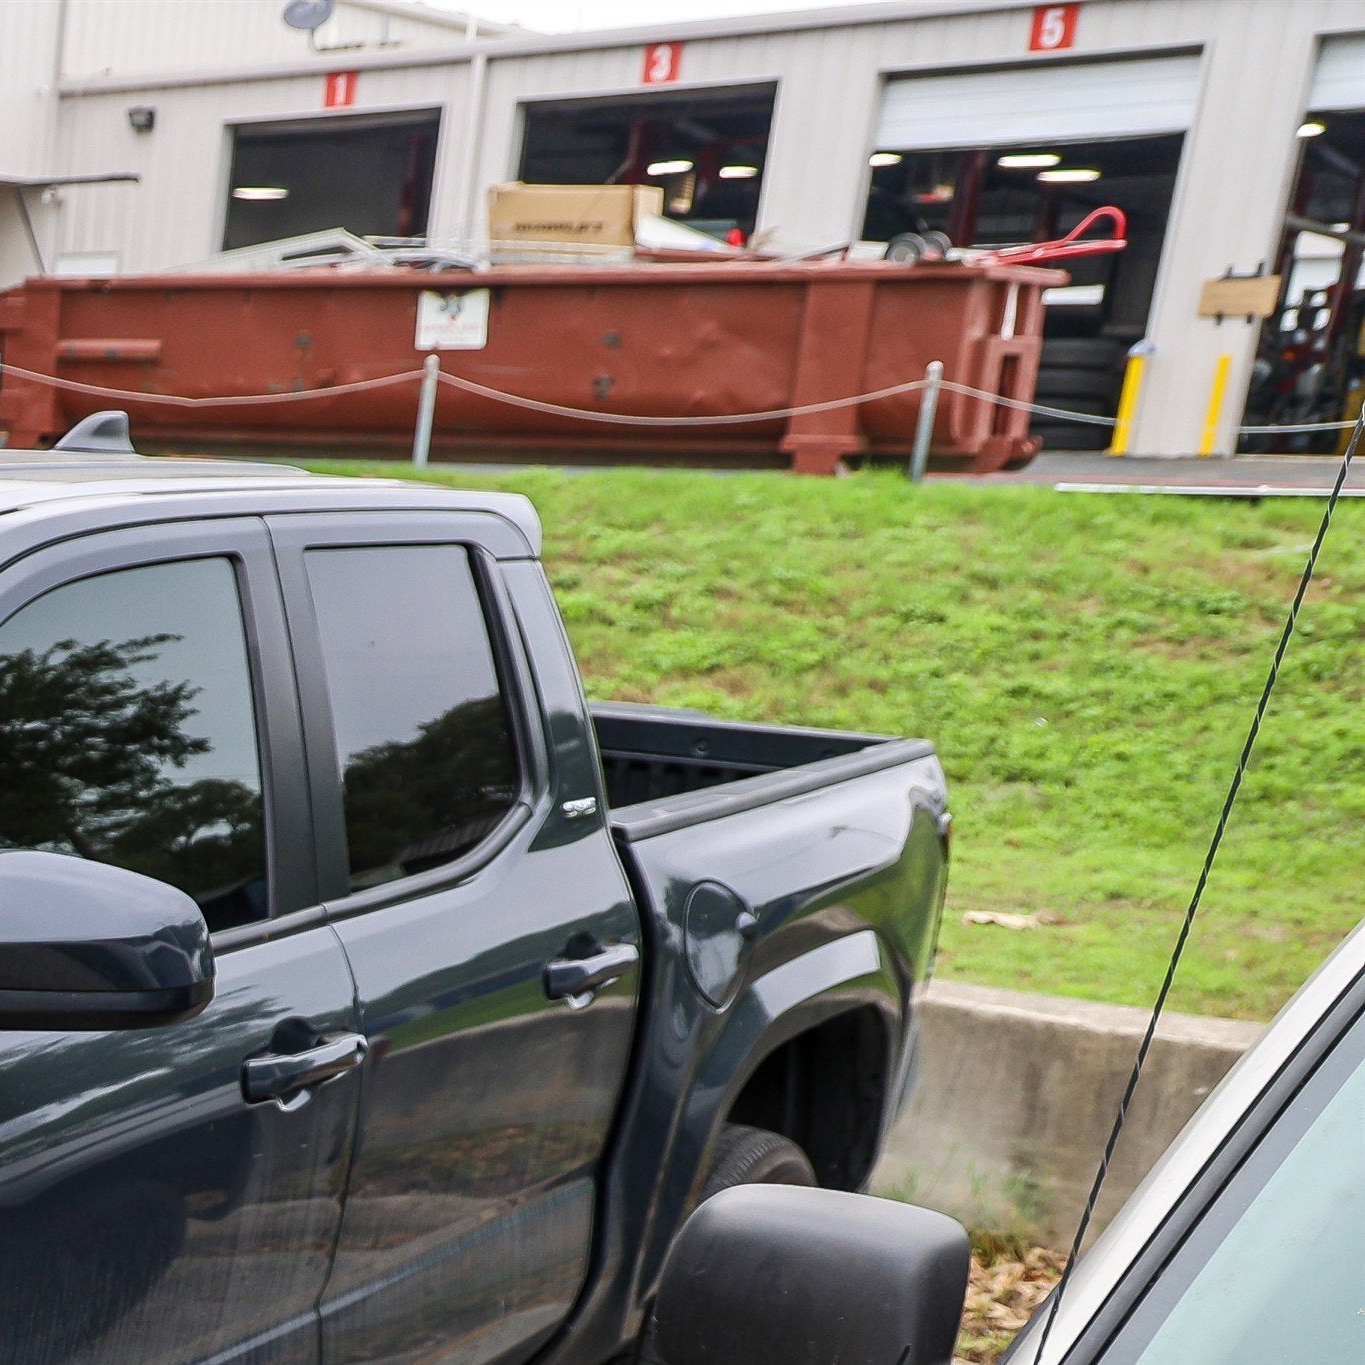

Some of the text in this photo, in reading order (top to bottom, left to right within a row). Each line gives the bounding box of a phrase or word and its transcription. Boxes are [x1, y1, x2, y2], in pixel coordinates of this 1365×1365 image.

[1038, 7, 1066, 47] 5
[650, 44, 673, 80] 3
[334, 74, 348, 104] 1
